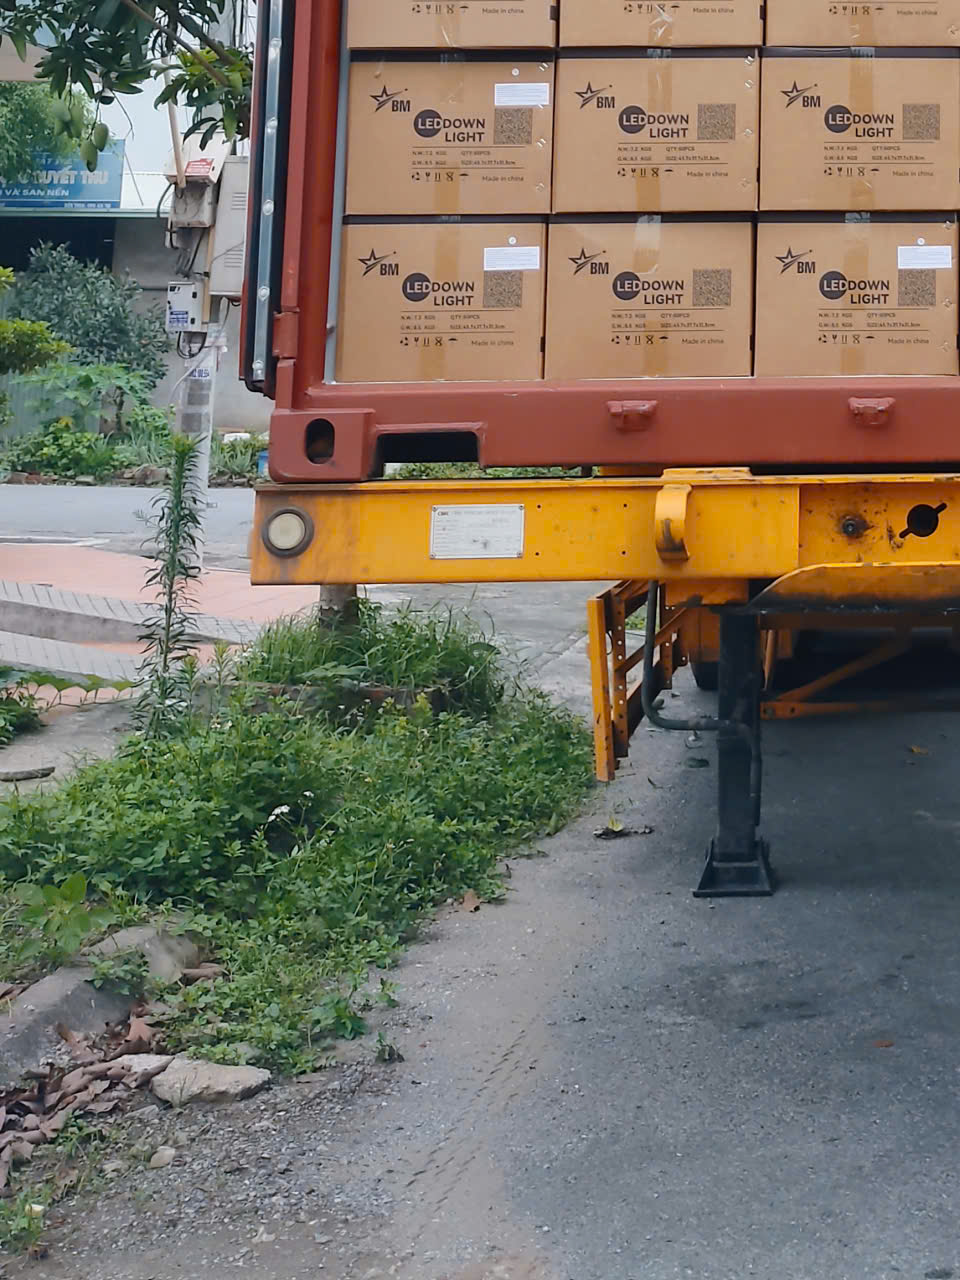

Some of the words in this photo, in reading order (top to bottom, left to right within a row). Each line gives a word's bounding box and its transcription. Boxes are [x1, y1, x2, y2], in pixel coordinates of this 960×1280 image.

[391, 99, 411, 113] BM
[596, 96, 615, 109] BM
[802, 95, 821, 108] BM
[445, 131, 485, 142] LIGHT
[649, 127, 689, 138] LIGHT
[855, 127, 894, 138] LIGHT
[380, 263, 399, 276] BM
[590, 262, 609, 275] BM
[797, 261, 815, 274] BM
[433, 295, 474, 306] LIGHT
[644, 293, 684, 305] LIGHT
[850, 293, 890, 304] LIGHT
